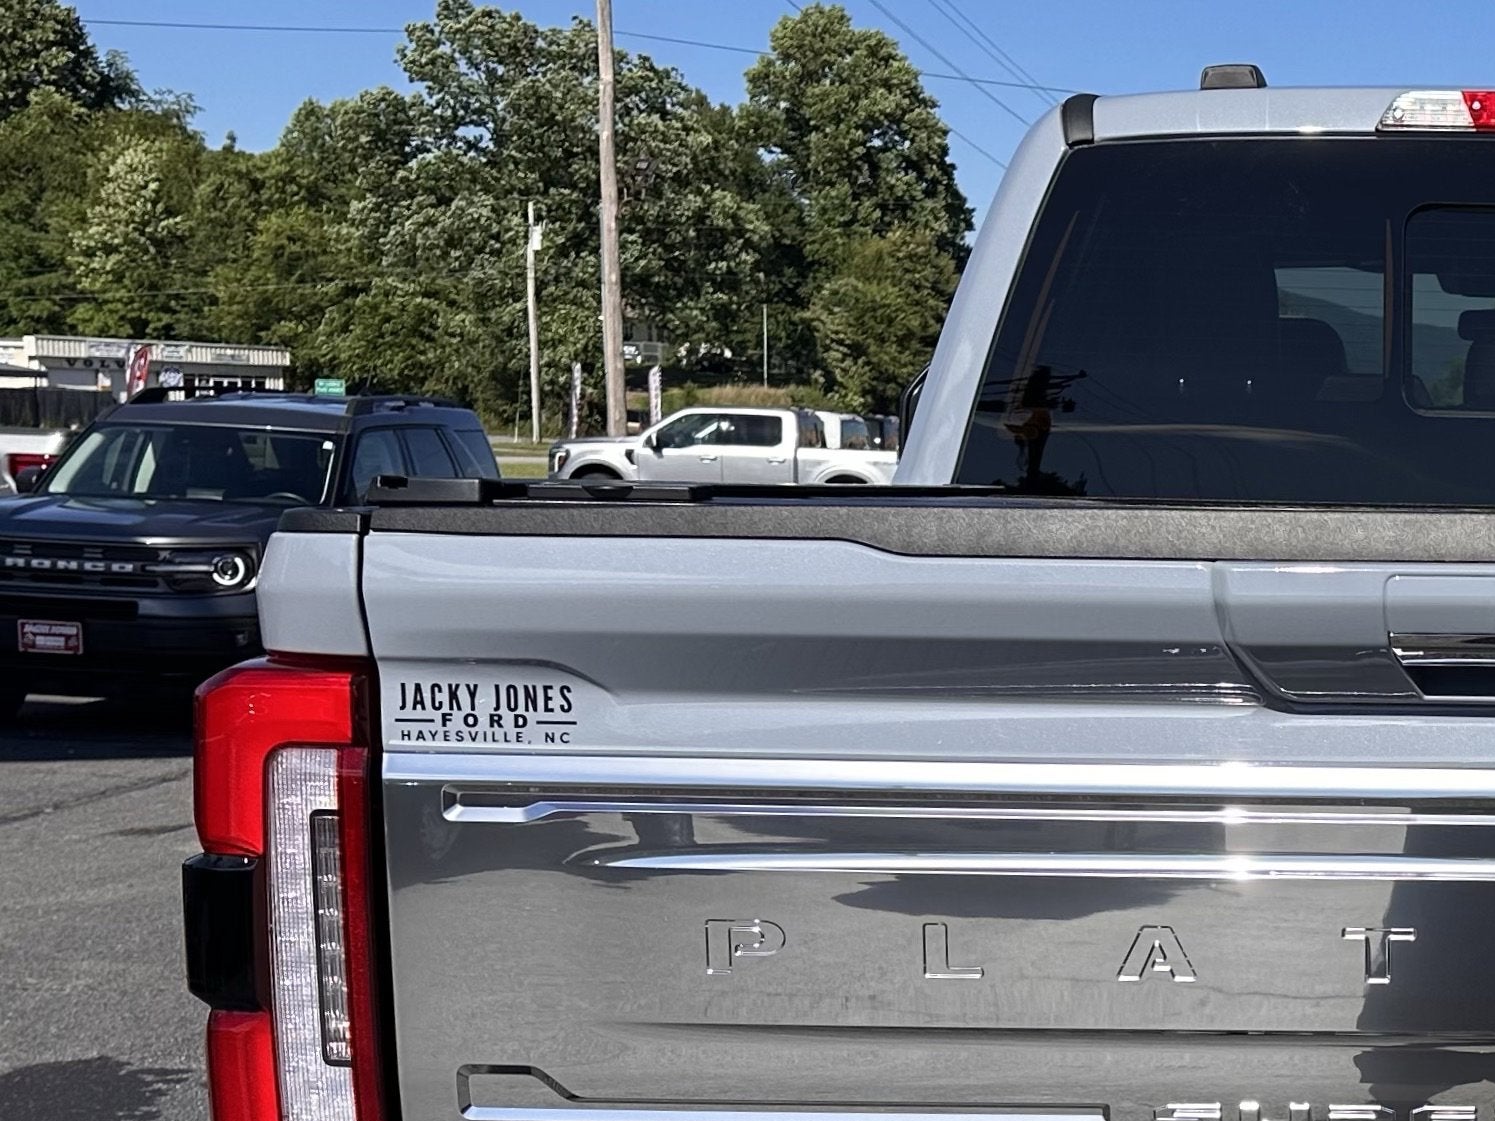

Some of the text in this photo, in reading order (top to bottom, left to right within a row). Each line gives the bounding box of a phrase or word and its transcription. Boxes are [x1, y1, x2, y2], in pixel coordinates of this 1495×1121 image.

[5, 557, 134, 573] RONCO
[400, 682, 573, 713] JACKY JONES
[440, 712, 528, 729] FORD
[401, 730, 571, 745] HAYESVILLE, NC
